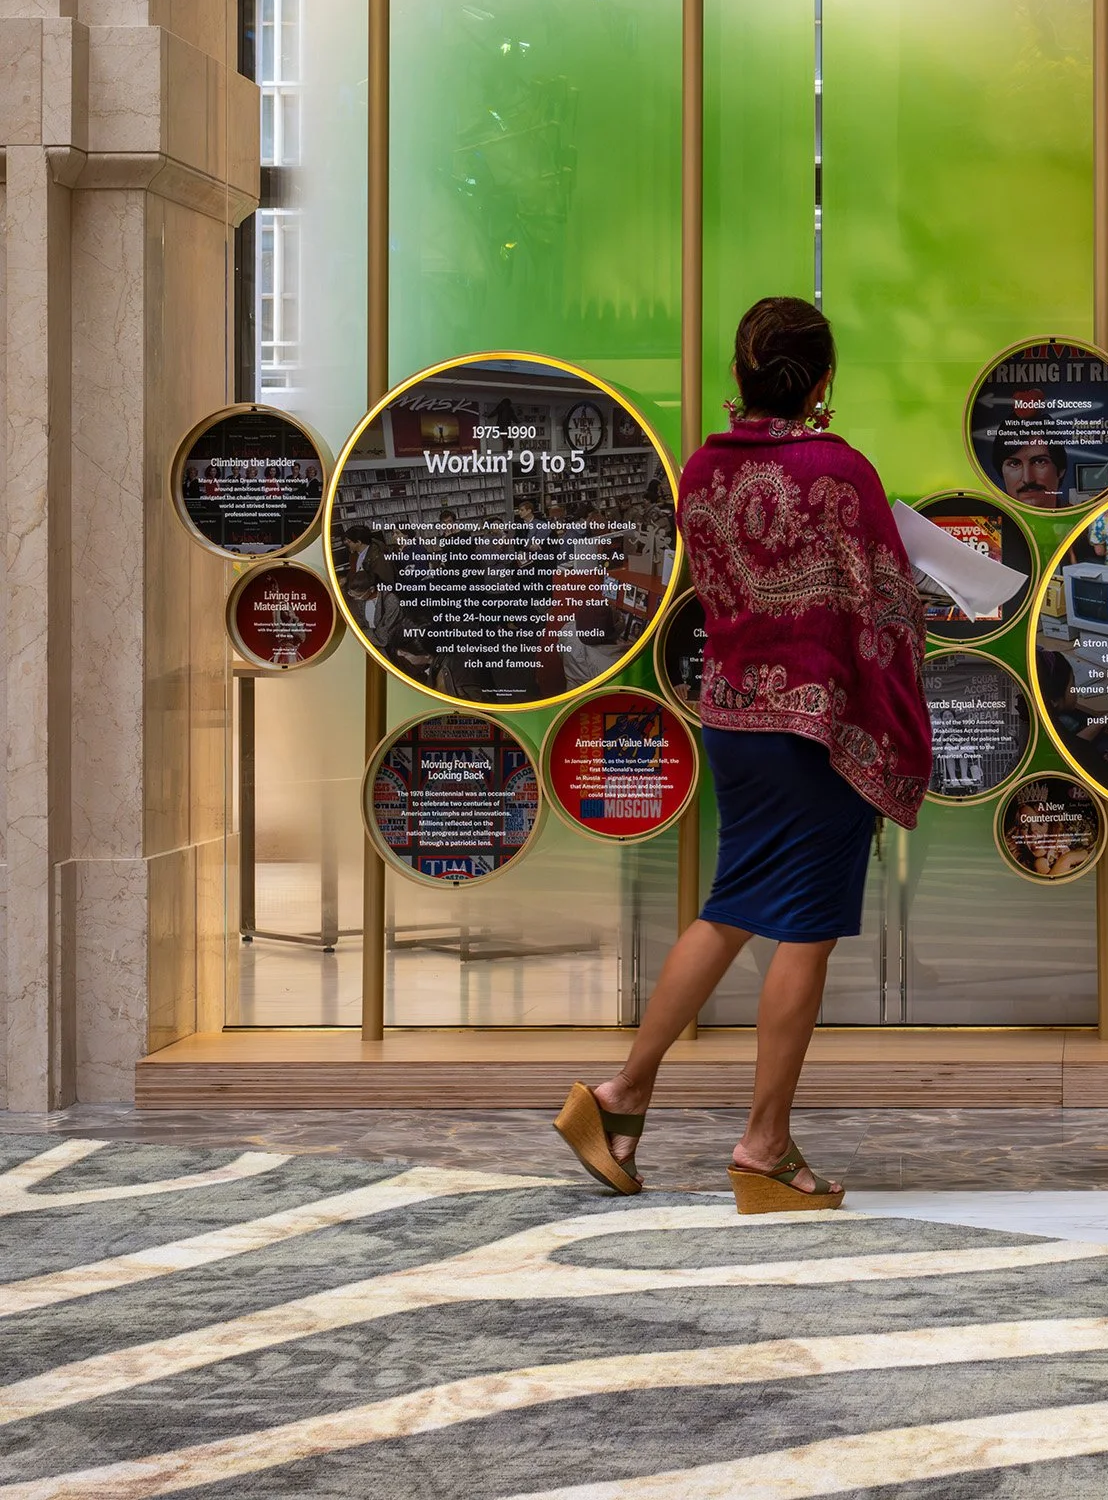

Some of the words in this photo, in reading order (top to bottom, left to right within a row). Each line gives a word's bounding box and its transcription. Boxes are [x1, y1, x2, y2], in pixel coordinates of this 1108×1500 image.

[1066, 363, 1084, 383] IT
[1015, 400, 1045, 409] Models
[1047, 399, 1056, 408] of
[1057, 400, 1092, 408] Success
[1089, 419, 1101, 427] and
[473, 426, 536, 439] 1975–1990
[210, 458, 249, 469] Climbing
[250, 458, 265, 467] the
[266, 458, 296, 467] Ladder
[520, 450, 534, 473] 9
[540, 451, 565, 473] to
[571, 450, 585, 473] 5
[373, 521, 381, 530] In
[435, 523, 480, 531] economy,
[482, 521, 534, 530] Americans
[536, 521, 587, 530] celebrated
[589, 521, 605, 529] the
[608, 521, 636, 530] ideals
[264, 590, 290, 602] Living
[291, 591, 299, 600] in
[254, 602, 290, 611] Material
[290, 602, 317, 611] World
[433, 613, 443, 622] of
[445, 613, 461, 622] the
[463, 613, 501, 622] 24-hour
[530, 613, 555, 623] cycle
[557, 613, 575, 622] and
[1073, 639, 1081, 647] A
[1088, 669, 1104, 678] the
[951, 699, 975, 710] Equal
[976, 699, 1006, 708] Access
[575, 738, 617, 747] American
[618, 738, 642, 747] Value
[644, 738, 669, 747] Meals
[421, 760, 453, 771] Moving
[454, 759, 491, 770] Forward,
[428, 771, 462, 782] Looking
[464, 771, 484, 780] Back
[604, 800, 662, 818] MOSCOW
[1038, 803, 1045, 811] A
[1046, 802, 1064, 811] New
[1020, 813, 1082, 824] Counterculture
